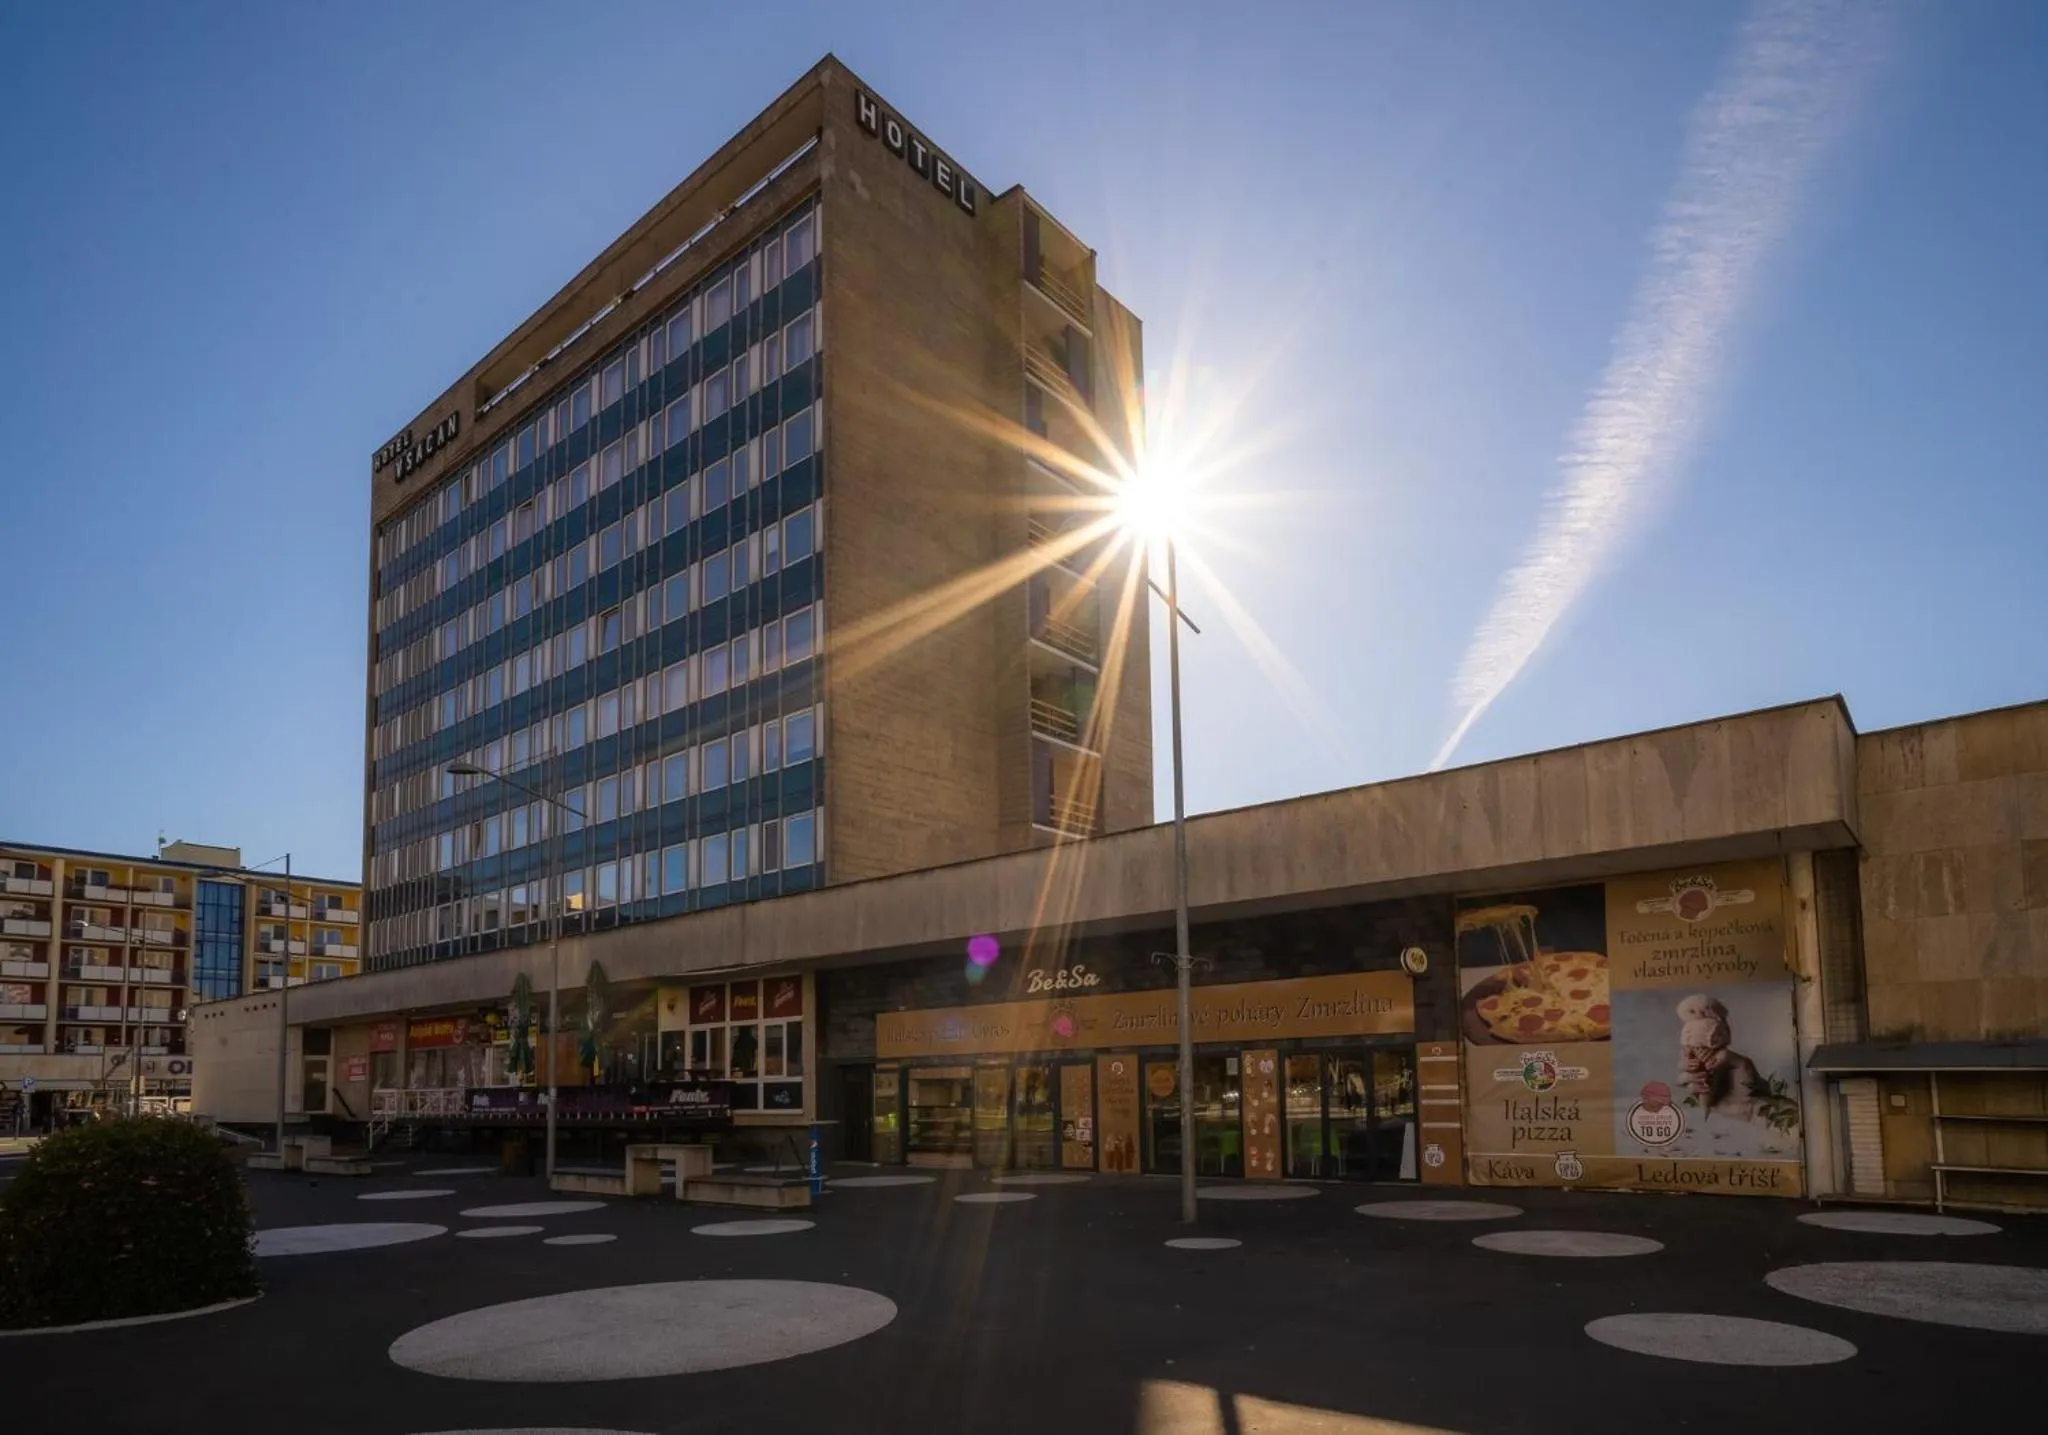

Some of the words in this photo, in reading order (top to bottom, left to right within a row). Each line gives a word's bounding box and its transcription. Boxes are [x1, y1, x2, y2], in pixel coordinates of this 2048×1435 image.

[859, 92, 974, 212] HOTEL
[374, 432, 411, 471] HOTEL
[395, 413, 459, 480] VSACAN
[1618, 926, 1670, 944] Točená
[1675, 931, 1683, 940] a
[1688, 917, 1774, 943] kopečková
[1651, 939, 1736, 961] zmrzlina
[1027, 963, 1101, 994] Be&Sa
[1634, 959, 1691, 978] vlastní
[1696, 953, 1759, 979] výroby
[1112, 1003, 1210, 1032] Zmrzlinvé
[1217, 997, 1287, 1031] poháry
[1297, 986, 1394, 1020] Zmrzlina
[1504, 1094, 1582, 1121] Italská
[1511, 1123, 1575, 1149] pizza
[1640, 1126, 1653, 1137] TO
[1657, 1126, 1671, 1137] GO
[1488, 1159, 1535, 1179] Káva
[1636, 1160, 1720, 1185] Ledová
[1728, 1163, 1781, 1189] tříšť
